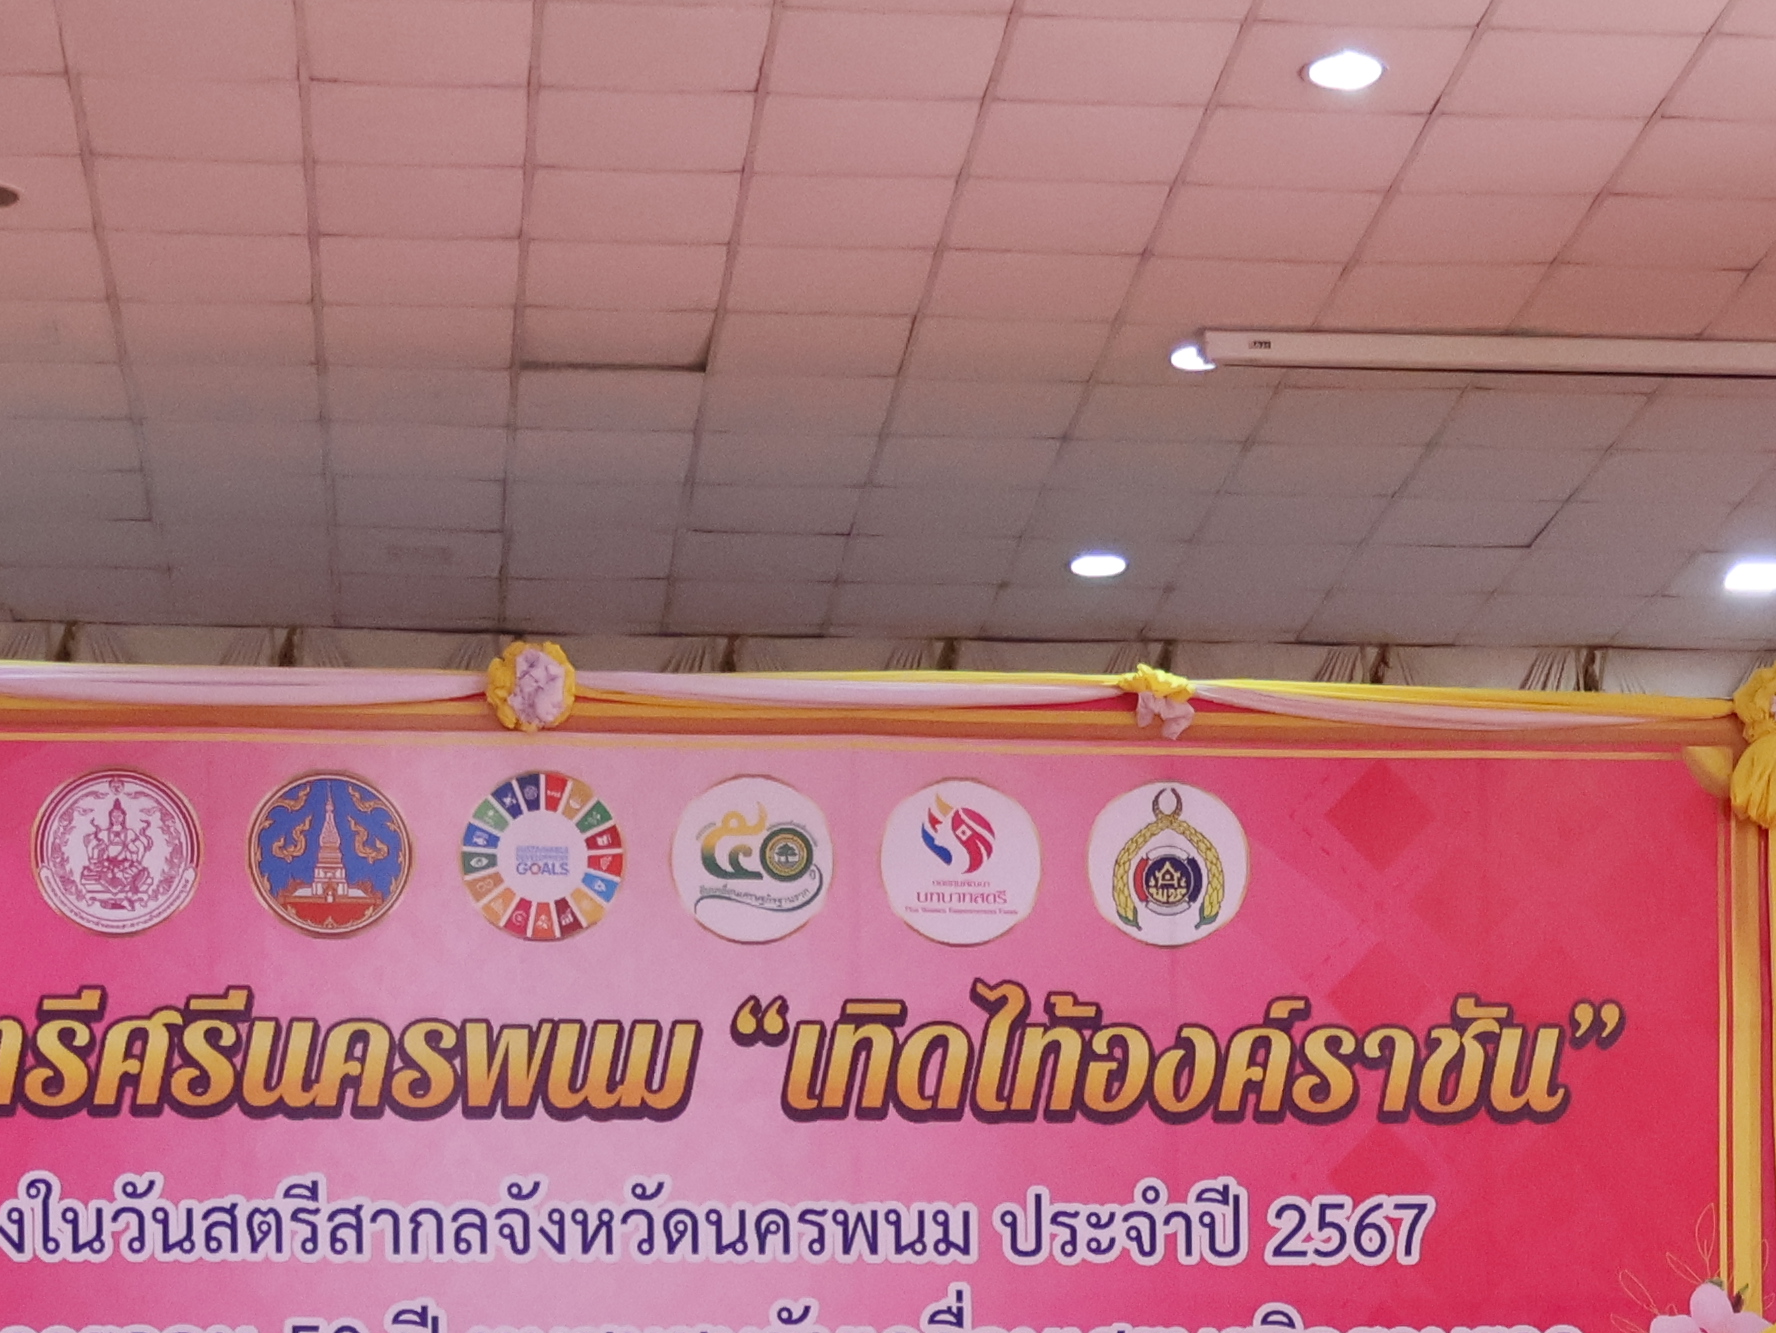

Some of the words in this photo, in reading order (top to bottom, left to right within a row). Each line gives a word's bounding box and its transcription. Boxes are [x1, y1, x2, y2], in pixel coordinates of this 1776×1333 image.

[516, 862, 569, 876] GOALS
[1000, 1184, 1242, 1259] ประจำปี
[1272, 1203, 1429, 1258] 2567
